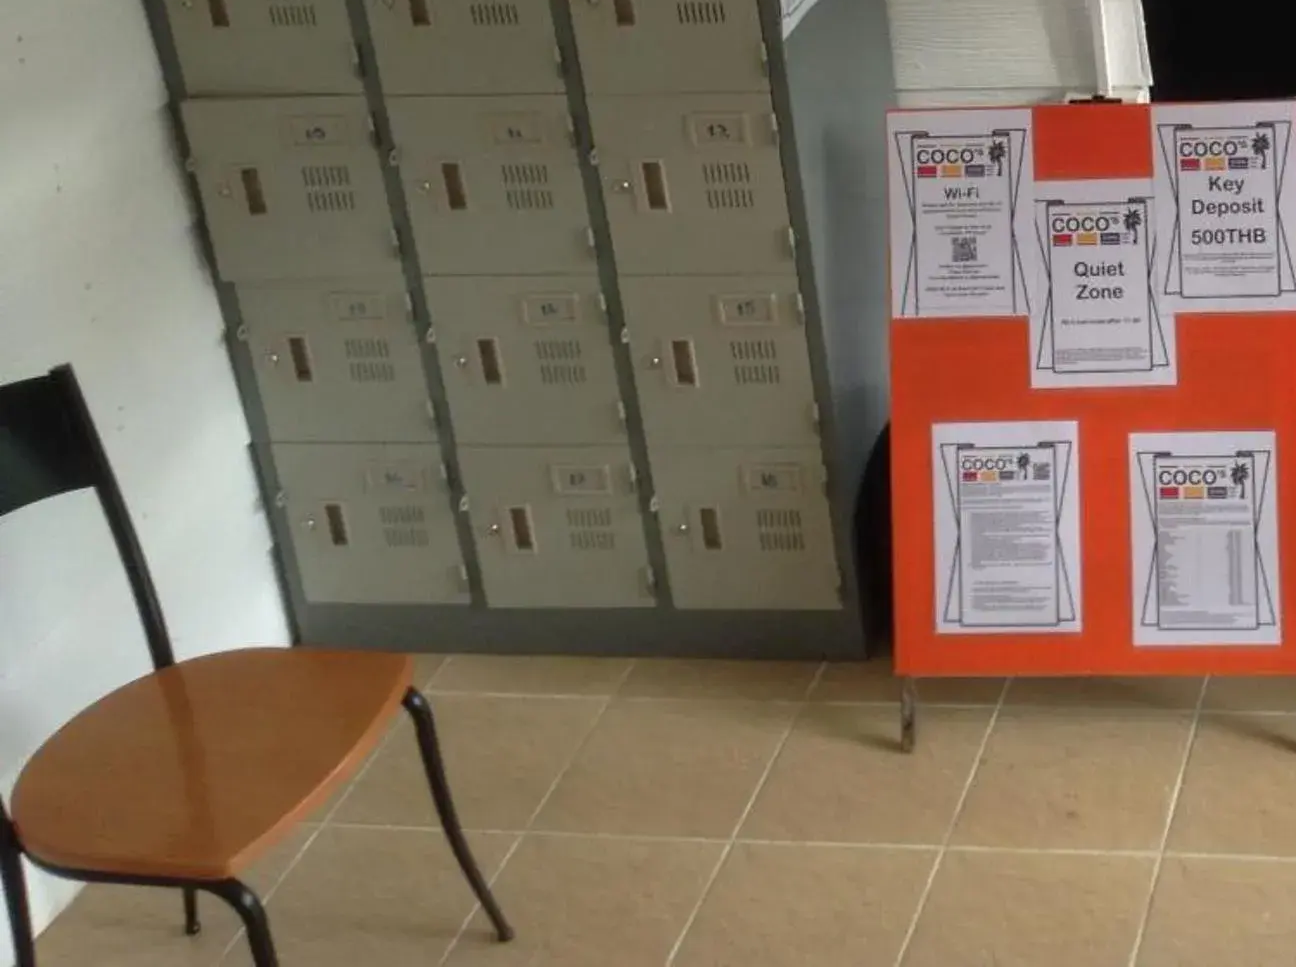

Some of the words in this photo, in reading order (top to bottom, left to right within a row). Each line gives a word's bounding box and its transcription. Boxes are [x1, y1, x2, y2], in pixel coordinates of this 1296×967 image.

[944, 187, 980, 199] Wi-Fi
[1208, 176, 1245, 195] Key
[1191, 197, 1265, 217] Deposit
[1191, 228, 1266, 245] 500THB
[1074, 261, 1126, 278] Quiet
[1075, 284, 1124, 300] Zone
